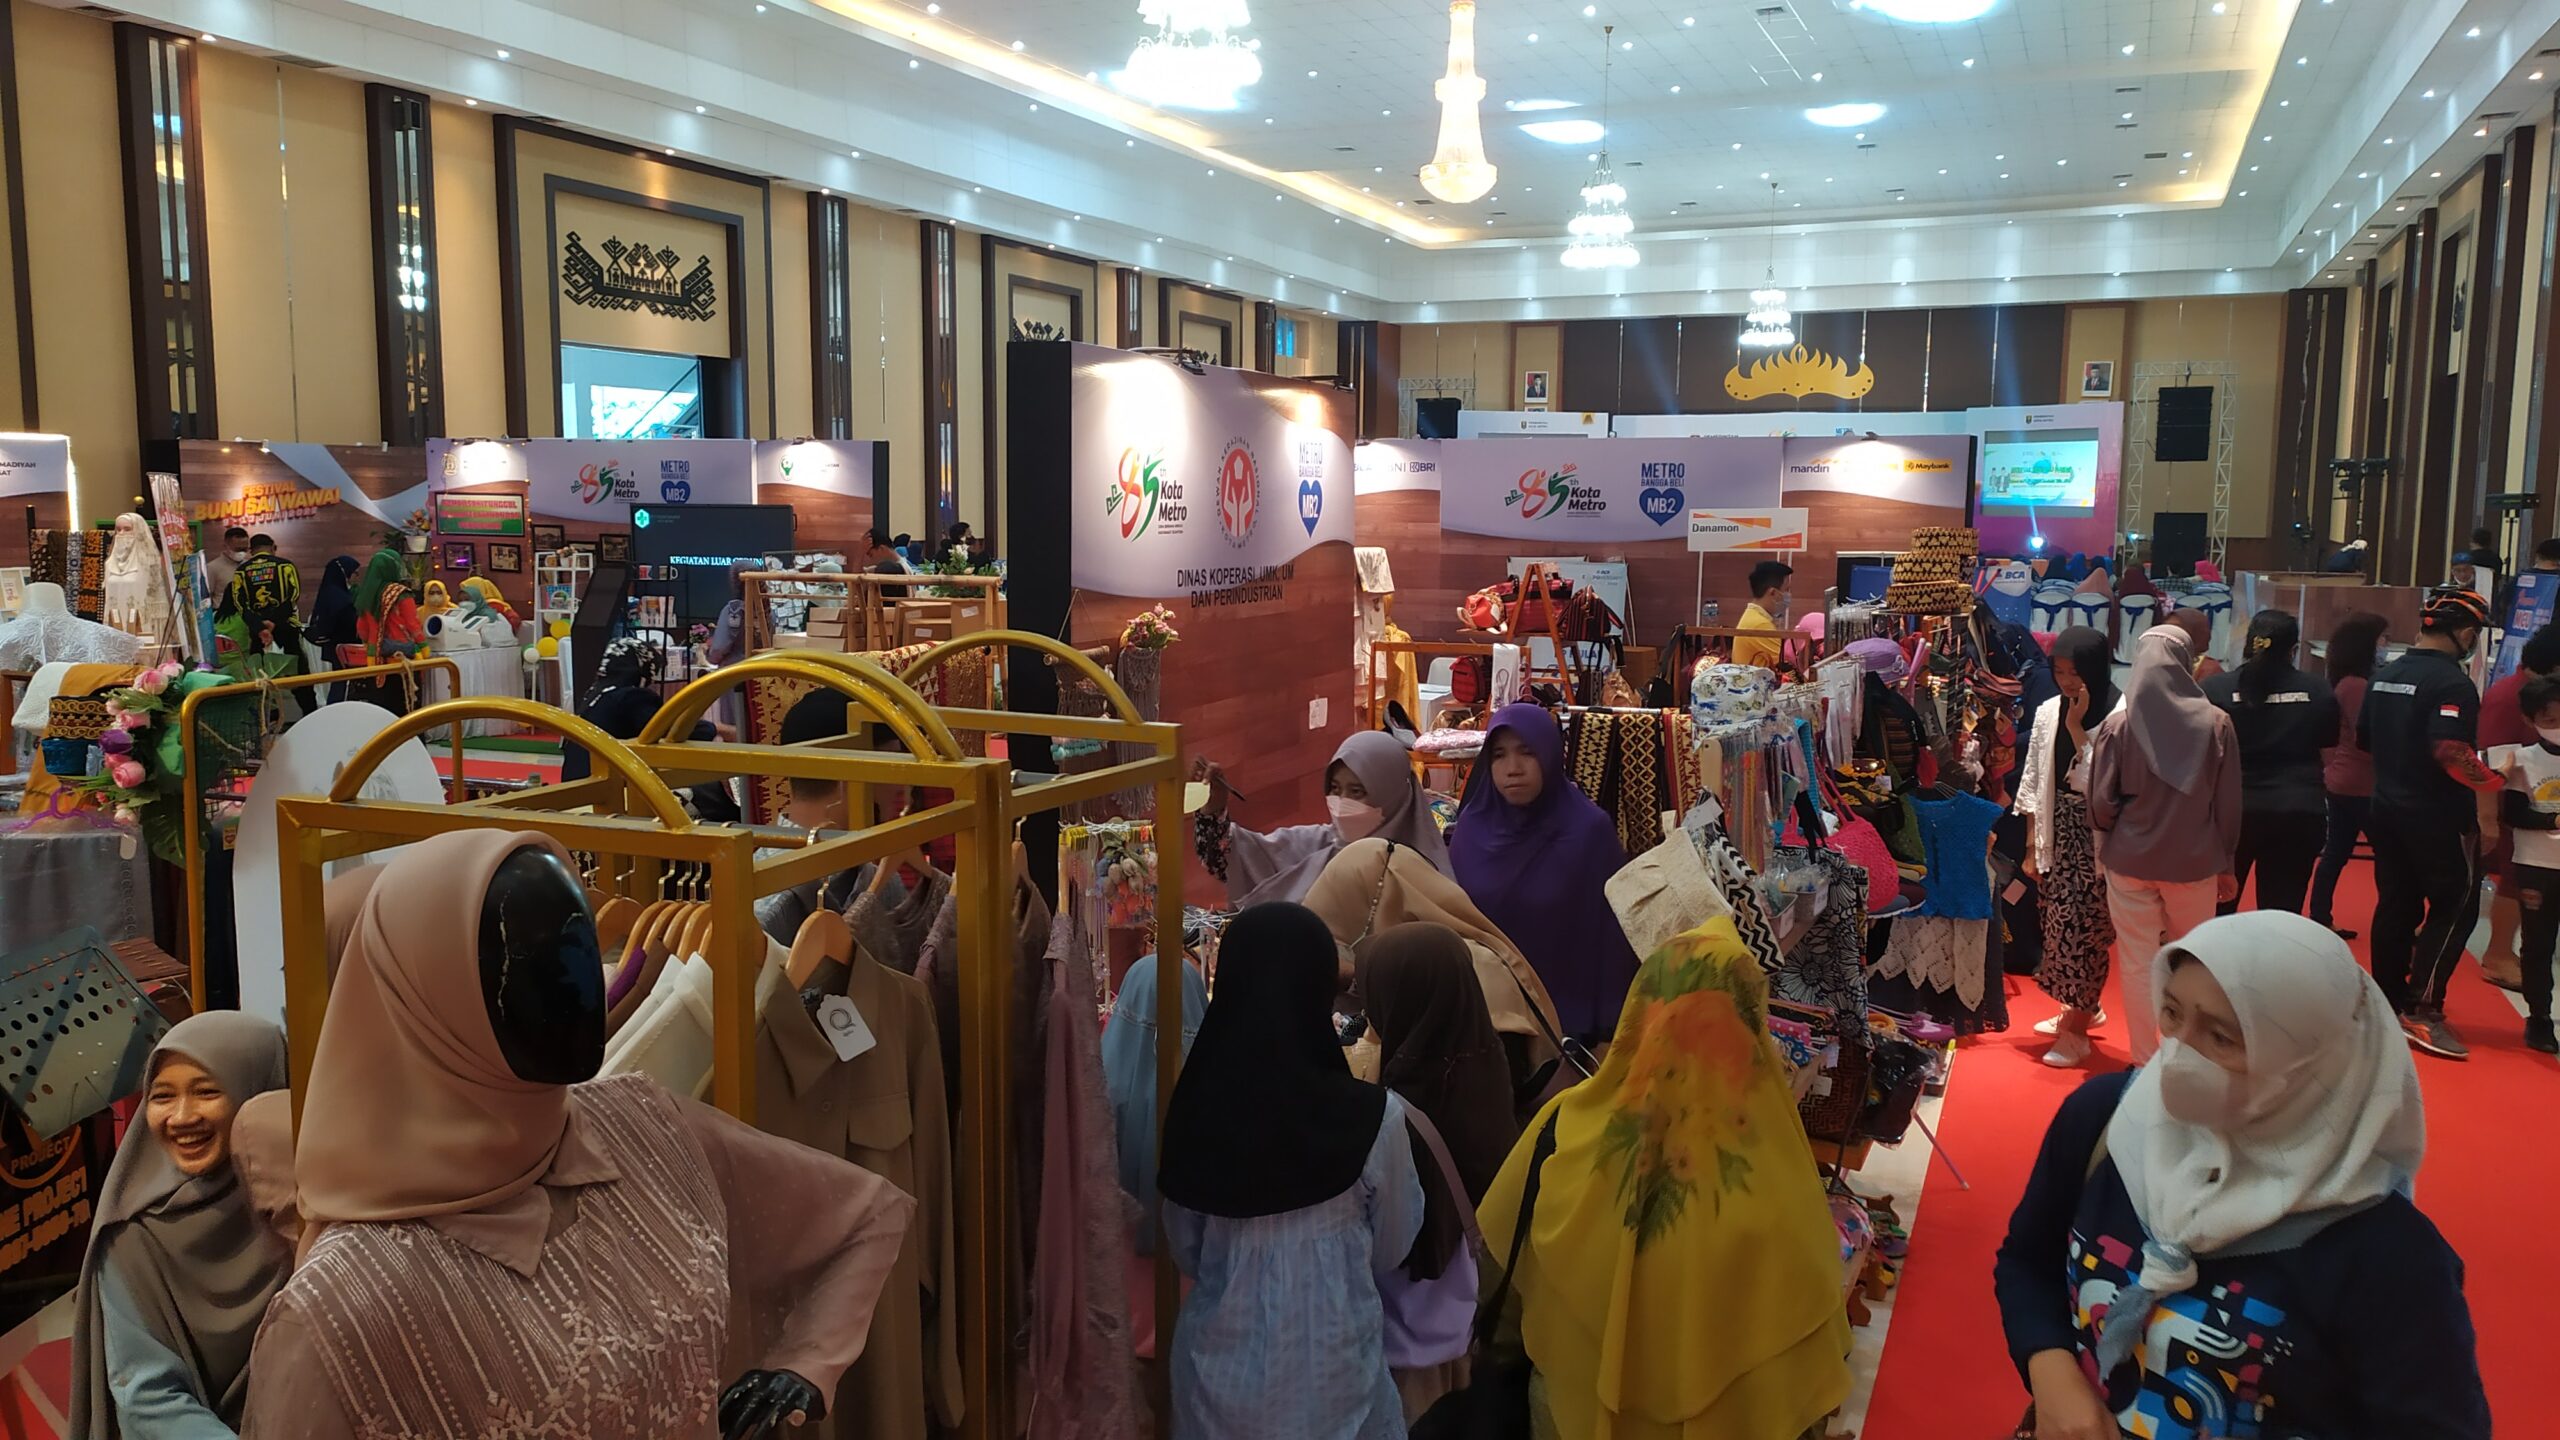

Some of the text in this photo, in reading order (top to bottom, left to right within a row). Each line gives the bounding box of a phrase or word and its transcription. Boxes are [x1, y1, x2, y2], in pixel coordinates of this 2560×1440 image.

[660, 460, 690, 473] METRO
[1420, 462, 1436, 472] BRI
[1641, 463, 1685, 479] METRO
[1915, 462, 1950, 472] Maybank
[242, 482, 297, 498] FESTIVAL
[615, 479, 636, 489] Kota
[1160, 480, 1184, 500] Kota
[1640, 479, 1669, 487] BANGGA
[613, 489, 640, 499] Metro
[665, 487, 686, 502] MB2
[1570, 487, 1601, 498] Kota
[194, 487, 342, 521] BUMI SAI WAWAI
[1302, 495, 1319, 519] MB2
[1567, 499, 1607, 511] Metro
[1646, 497, 1677, 514] MB2
[1158, 502, 1188, 522] Metro
[1691, 523, 1740, 533] Danamon
[669, 556, 710, 565] KEGIATAN
[710, 557, 731, 566] LUAR
[1177, 568, 1207, 588] DINAS
[1281, 563, 1295, 580] UM
[2004, 571, 2026, 580] BCA
[1191, 583, 1283, 609] DAN PERINDUSTRIAN
[10, 1135, 71, 1176] PROJECT
